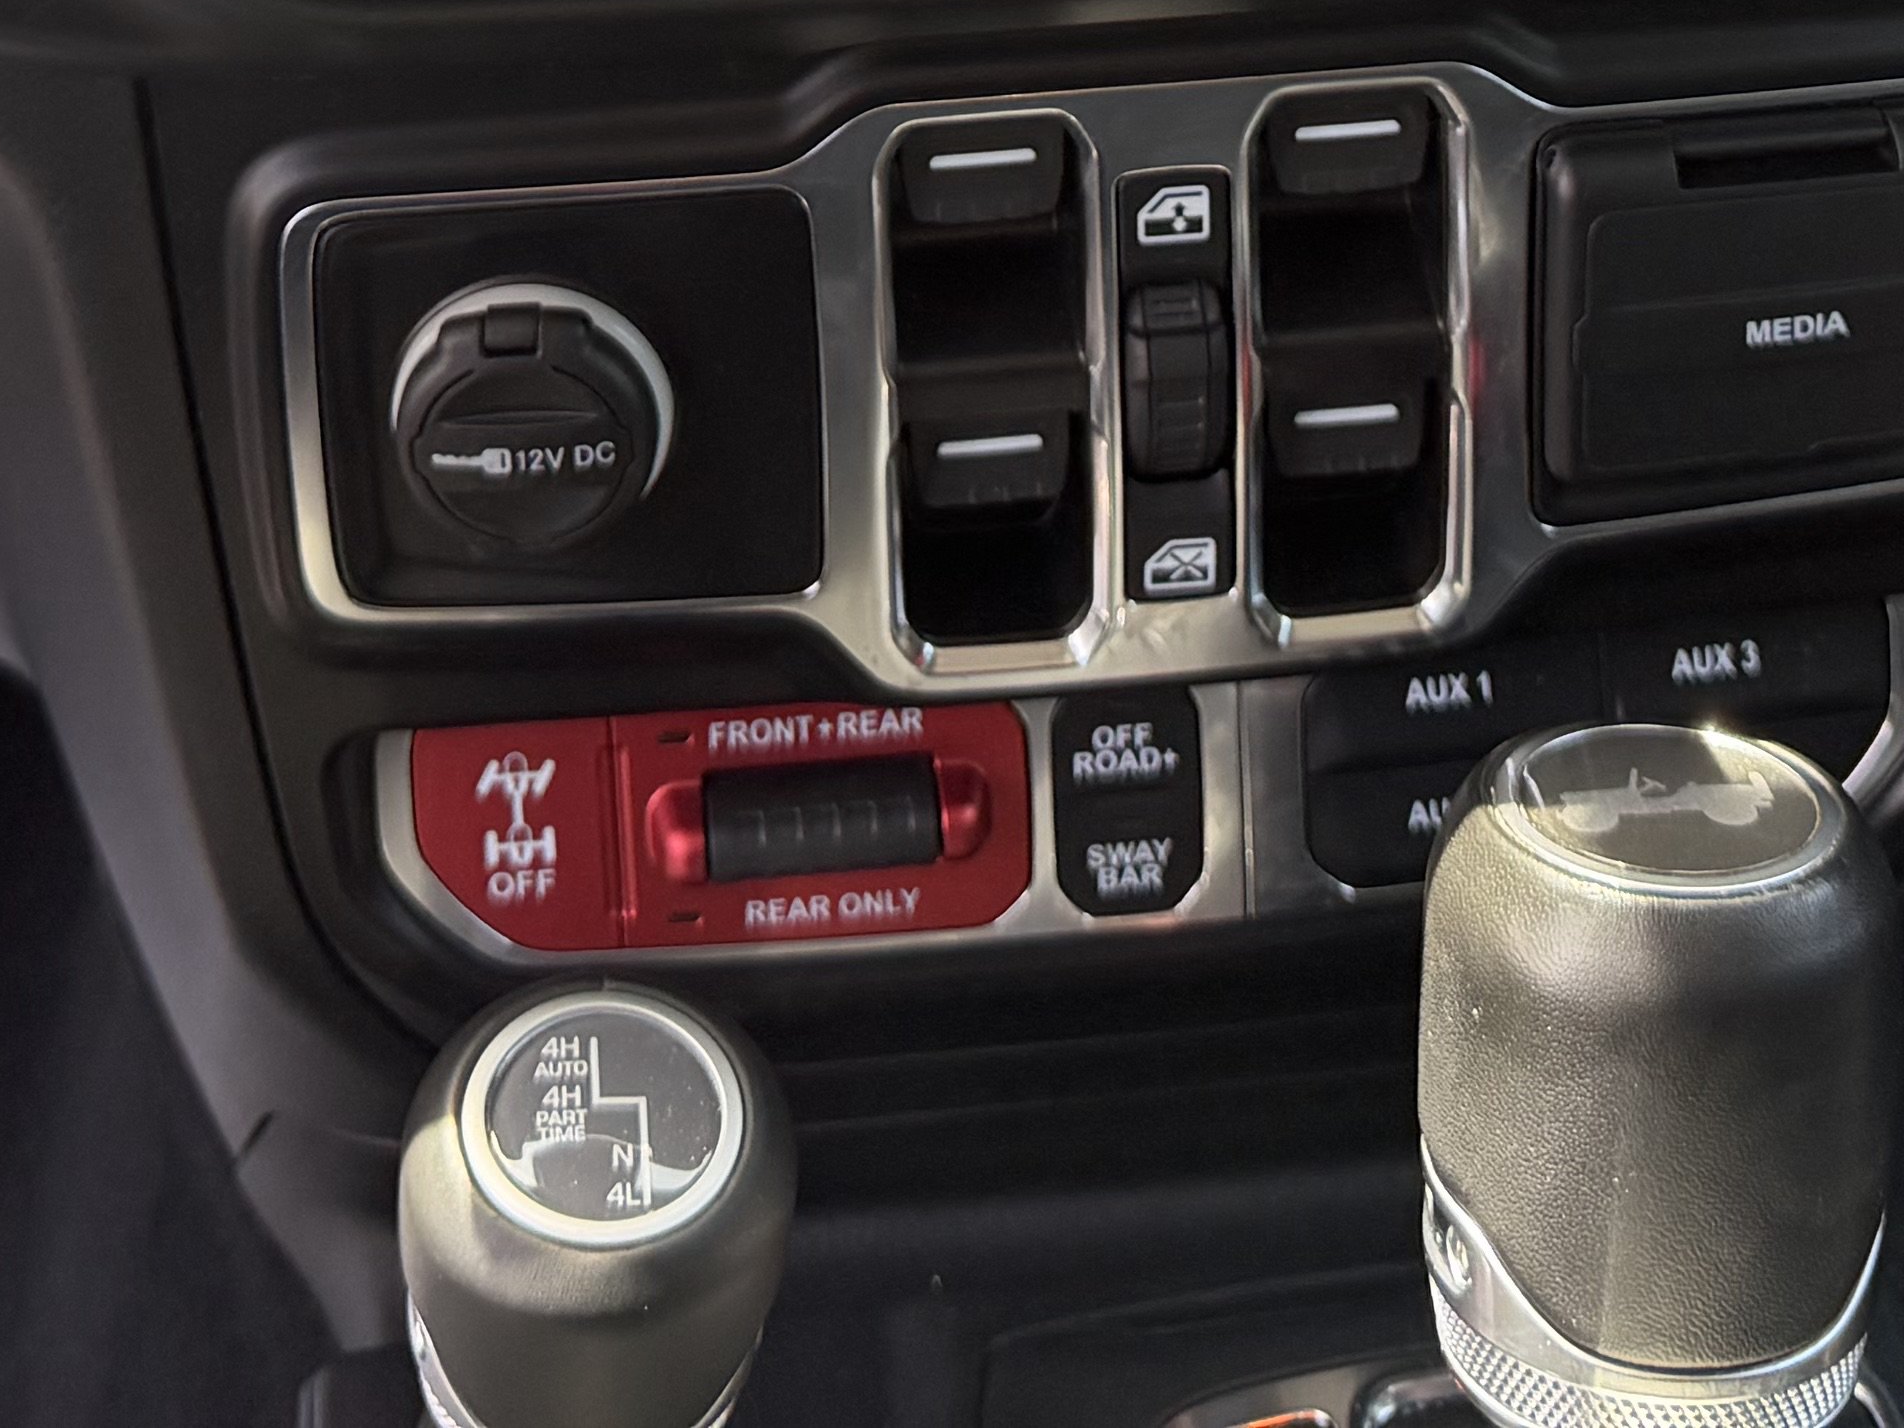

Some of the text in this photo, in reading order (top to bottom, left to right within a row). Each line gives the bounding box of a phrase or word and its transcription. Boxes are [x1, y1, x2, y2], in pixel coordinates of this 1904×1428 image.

[1746, 310, 1849, 348] MEDIA
[515, 441, 616, 474] 12V DC
[1672, 639, 1761, 685] AUX 3
[1405, 670, 1493, 713] AUX 1
[1091, 722, 1154, 750] OFF
[1086, 837, 1174, 871] SWAY
[487, 868, 557, 902] OFF
[1097, 863, 1165, 897] BAR
[745, 888, 921, 927] REAR ONLY
[541, 1036, 580, 1059] 4H
[533, 1060, 588, 1081] AUTO
[541, 1085, 582, 1109] 4H
[536, 1109, 588, 1127] PART
[539, 1124, 586, 1143] TIME
[612, 1144, 634, 1170] N
[606, 1182, 641, 1208] 4L
